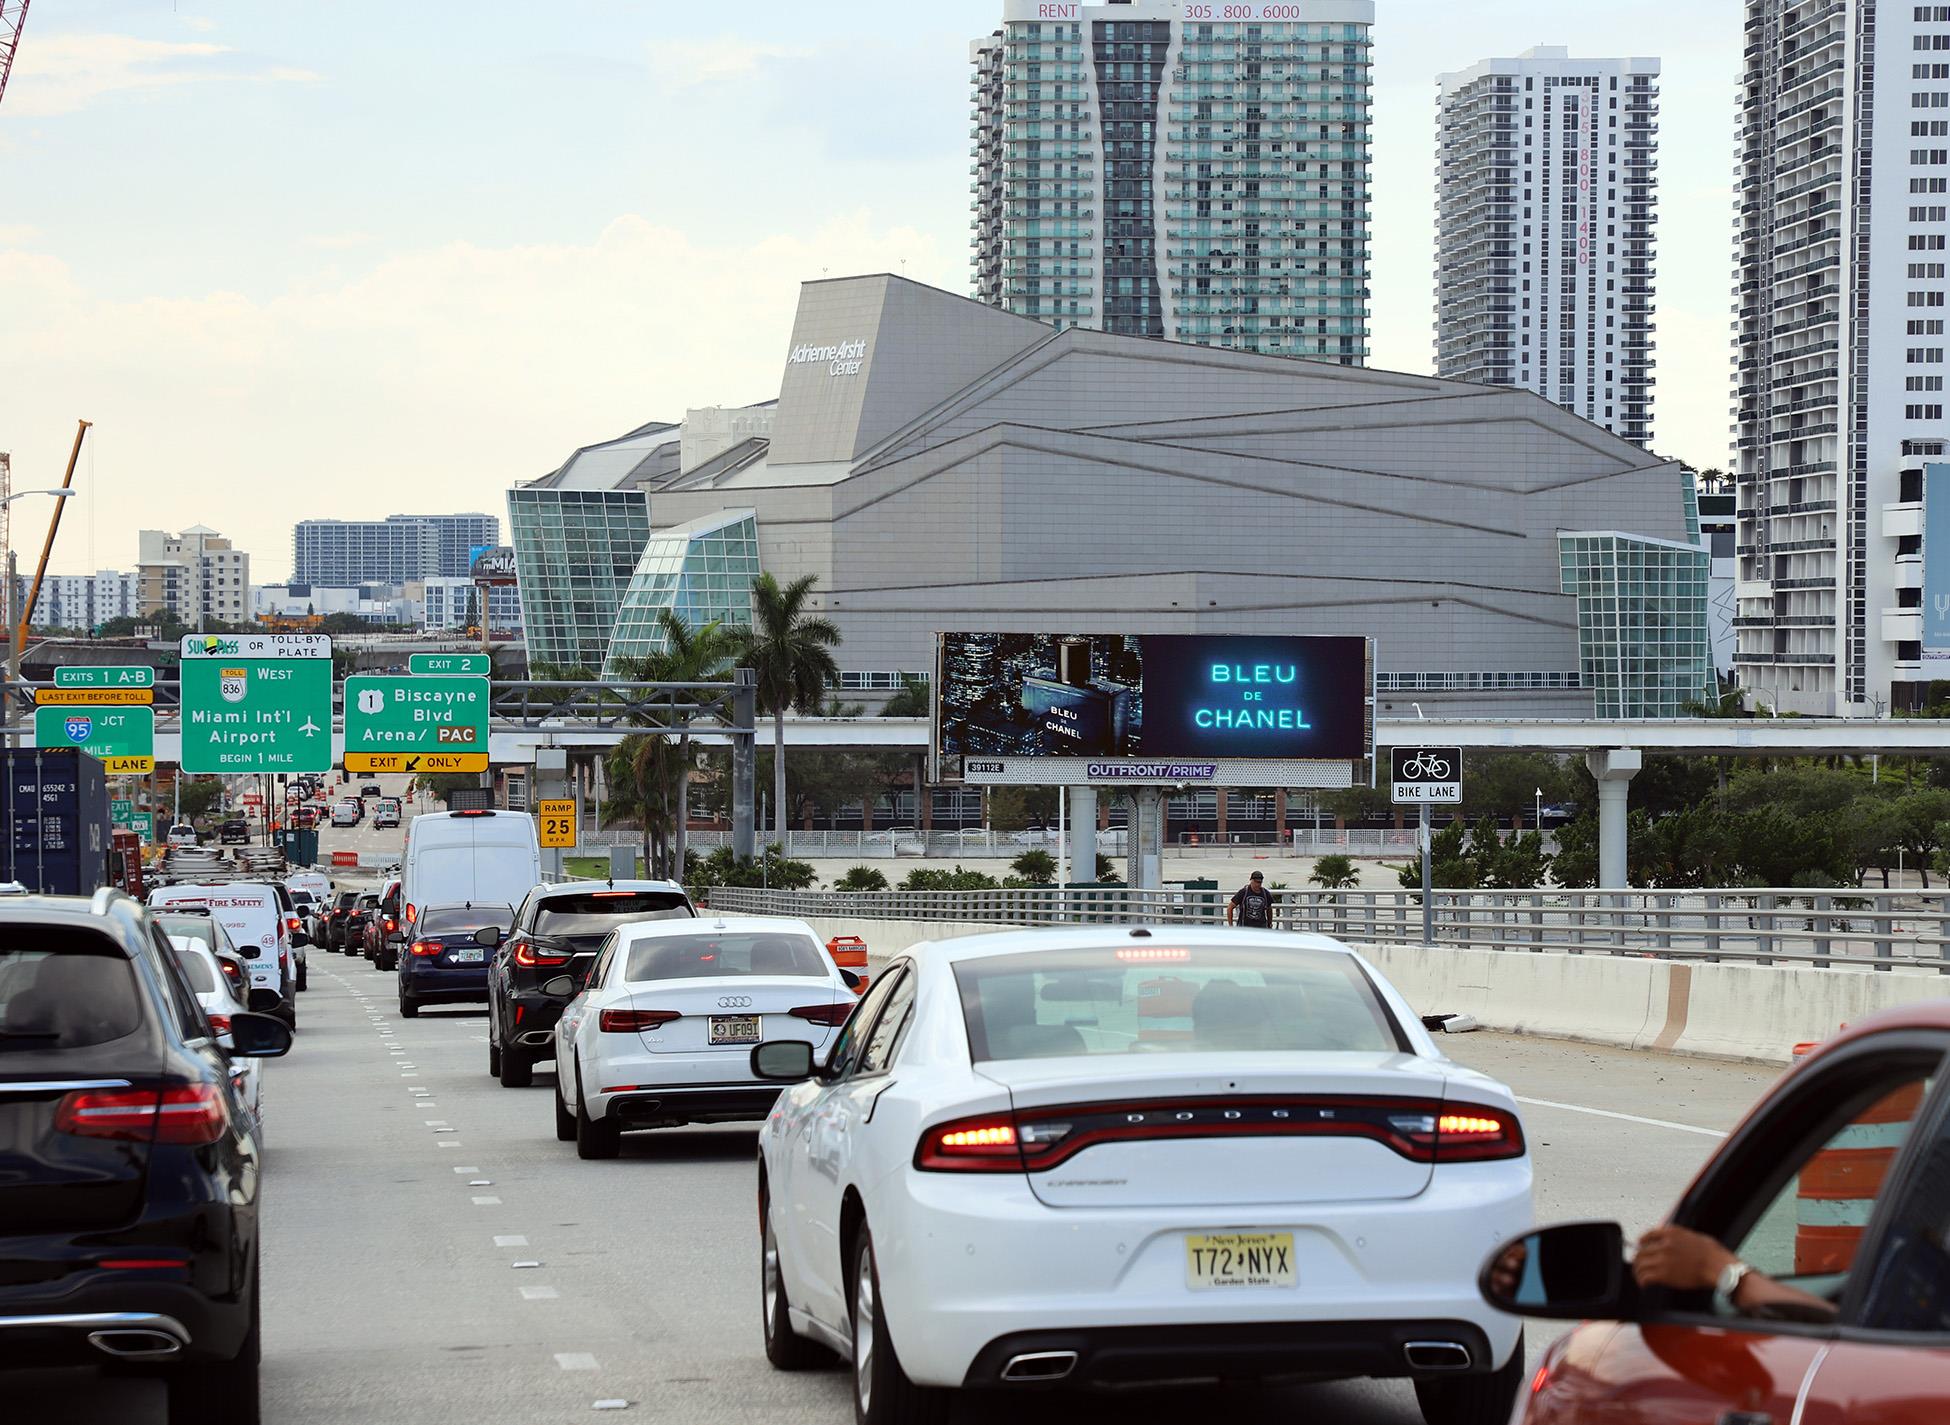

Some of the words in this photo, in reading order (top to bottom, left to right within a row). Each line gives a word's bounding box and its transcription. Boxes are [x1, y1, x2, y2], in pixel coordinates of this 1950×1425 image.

[1039, 4, 1077, 18] RENT
[788, 343, 837, 364] Adrienne
[835, 339, 866, 360] Arsht
[829, 359, 863, 377] Center
[271, 636, 325, 644] TOLL-BY-
[249, 642, 264, 650] OR
[278, 648, 317, 656] PLATE
[428, 660, 451, 669] EXIT
[461, 659, 471, 671] 2
[62, 673, 94, 682] EXITS
[103, 672, 109, 683] 1
[118, 672, 146, 683] A-B
[1211, 664, 1296, 683] BLEU
[223, 684, 240, 694] 836
[368, 695, 373, 708] 1
[394, 689, 477, 705] Biscayne
[1243, 691, 1263, 701] DE
[192, 710, 247, 723] Miami
[256, 710, 291, 723] Int'l
[414, 709, 453, 722] Blvd
[1050, 705, 1078, 720] BLEU
[1195, 708, 1312, 729] CHANEL
[67, 723, 88, 737] 95
[100, 716, 125, 726] JCT
[1045, 721, 1082, 740] CHANEL
[209, 730, 276, 745] Airport
[439, 729, 474, 742] PAC
[220, 754, 252, 763] BEGIN
[258, 753, 263, 764] 1
[268, 754, 293, 762] MILE
[370, 758, 398, 767] EXIT
[427, 758, 462, 767] ONLY
[113, 760, 147, 769] LANE
[971, 764, 1000, 772] 39112E
[69, 783, 75, 792] 3
[1398, 786, 1421, 797] BIKE
[1429, 786, 1455, 797] LANE
[112, 802, 130, 811] EXIT
[544, 804, 572, 812] RAMP
[546, 819, 570, 834] 25
[262, 935, 274, 945] 49
[1214, 1277, 1244, 1287] Garden
[1248, 1276, 1271, 1286] State
